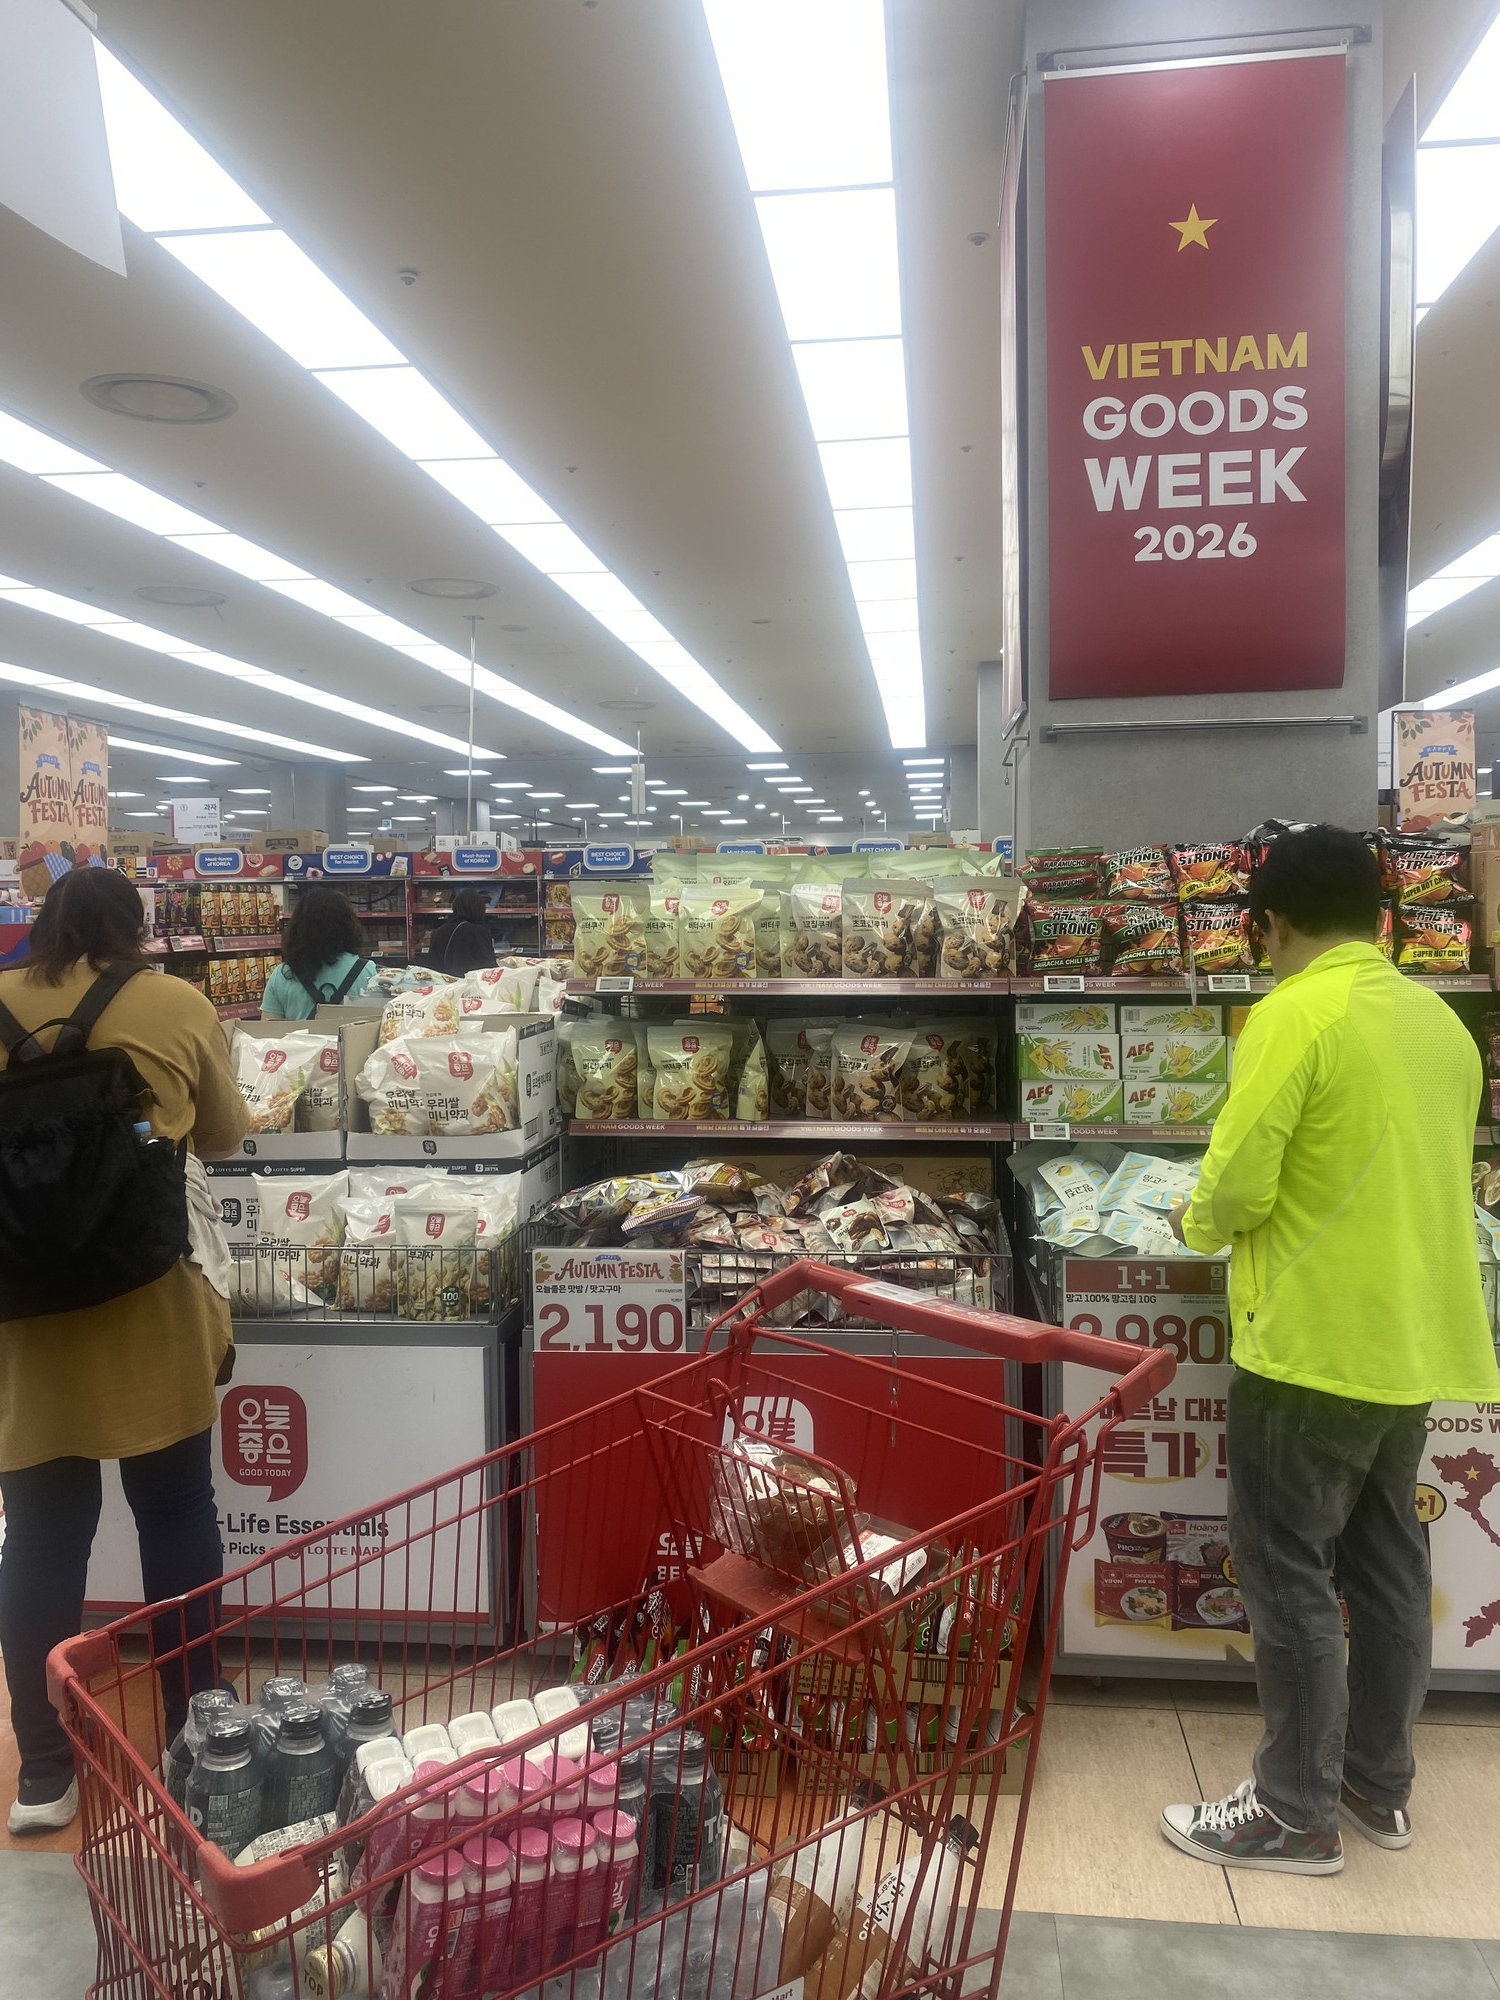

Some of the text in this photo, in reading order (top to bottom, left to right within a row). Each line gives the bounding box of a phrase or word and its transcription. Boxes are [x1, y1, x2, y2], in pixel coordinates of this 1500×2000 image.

[1081, 332, 1308, 380] VIETNAM
[1082, 386, 1308, 440] GOODS
[1084, 447, 1308, 512] WEEK
[1133, 522, 1257, 562] 2026
[1400, 761, 1475, 787] AUTUMN
[20, 772, 73, 803] AUTUMN
[1408, 781, 1472, 802] FESTA
[28, 799, 72, 825] FESTA
[75, 804, 107, 828] FESTA
[1044, 859, 1086, 867] KARAMUCHO
[1110, 852, 1160, 868] STRONG
[1178, 850, 1231, 865] STRONG
[1043, 879, 1085, 888] KARAMUCHO
[1403, 881, 1434, 900] SUPER HOT
[760, 920, 780, 929] 버터쿠
[1042, 922, 1097, 936] STRONG
[1124, 919, 1174, 939] STRONG
[1187, 917, 1240, 931] STRONG
[1408, 921, 1463, 934] STRONG
[1210, 949, 1222, 957] HOT
[1224, 945, 1239, 954] CHILI
[1413, 950, 1432, 958] SUPER
[1447, 949, 1464, 957] CHILI
[1034, 960, 1064, 969] SRIRACHA
[1065, 958, 1082, 966] CHILI
[1097, 1043, 1115, 1071] AFC
[1126, 1042, 1154, 1059] AFC
[236, 1083, 255, 1093] 리쌀
[386, 1089, 415, 1099] 우리쌀
[1026, 1085, 1053, 1101] AFC
[1128, 1087, 1156, 1104] AFC
[305, 1097, 333, 1109] 니약과
[427, 1097, 460, 1110] 우리쌀
[428, 1110, 469, 1122] 미니약과
[430, 1215, 442, 1223] 오늘
[555, 1258, 664, 1281] AUTUMN FESTA
[1117, 1266, 1171, 1290] 1+1
[443, 1292, 459, 1301] 100
[568, 1284, 583, 1293] 맛밤
[590, 1284, 621, 1294] 맛고구마
[1066, 1294, 1157, 1304] 망고 100% 망고칩 10G
[539, 1303, 683, 1352] 2,190
[237, 1398, 291, 1431] 오늘
[1475, 1402, 1500, 1414] VIE
[1424, 1417, 1484, 1433] OODS
[238, 1431, 291, 1465] 좋은
[264, 1469, 291, 1477] TODAY
[1414, 1495, 1436, 1515] +1
[216, 1513, 270, 1534] -Life
[229, 1542, 266, 1556] Picks
[308, 1546, 347, 1556] LOTTE
[304, 1970, 325, 1997] TOP
